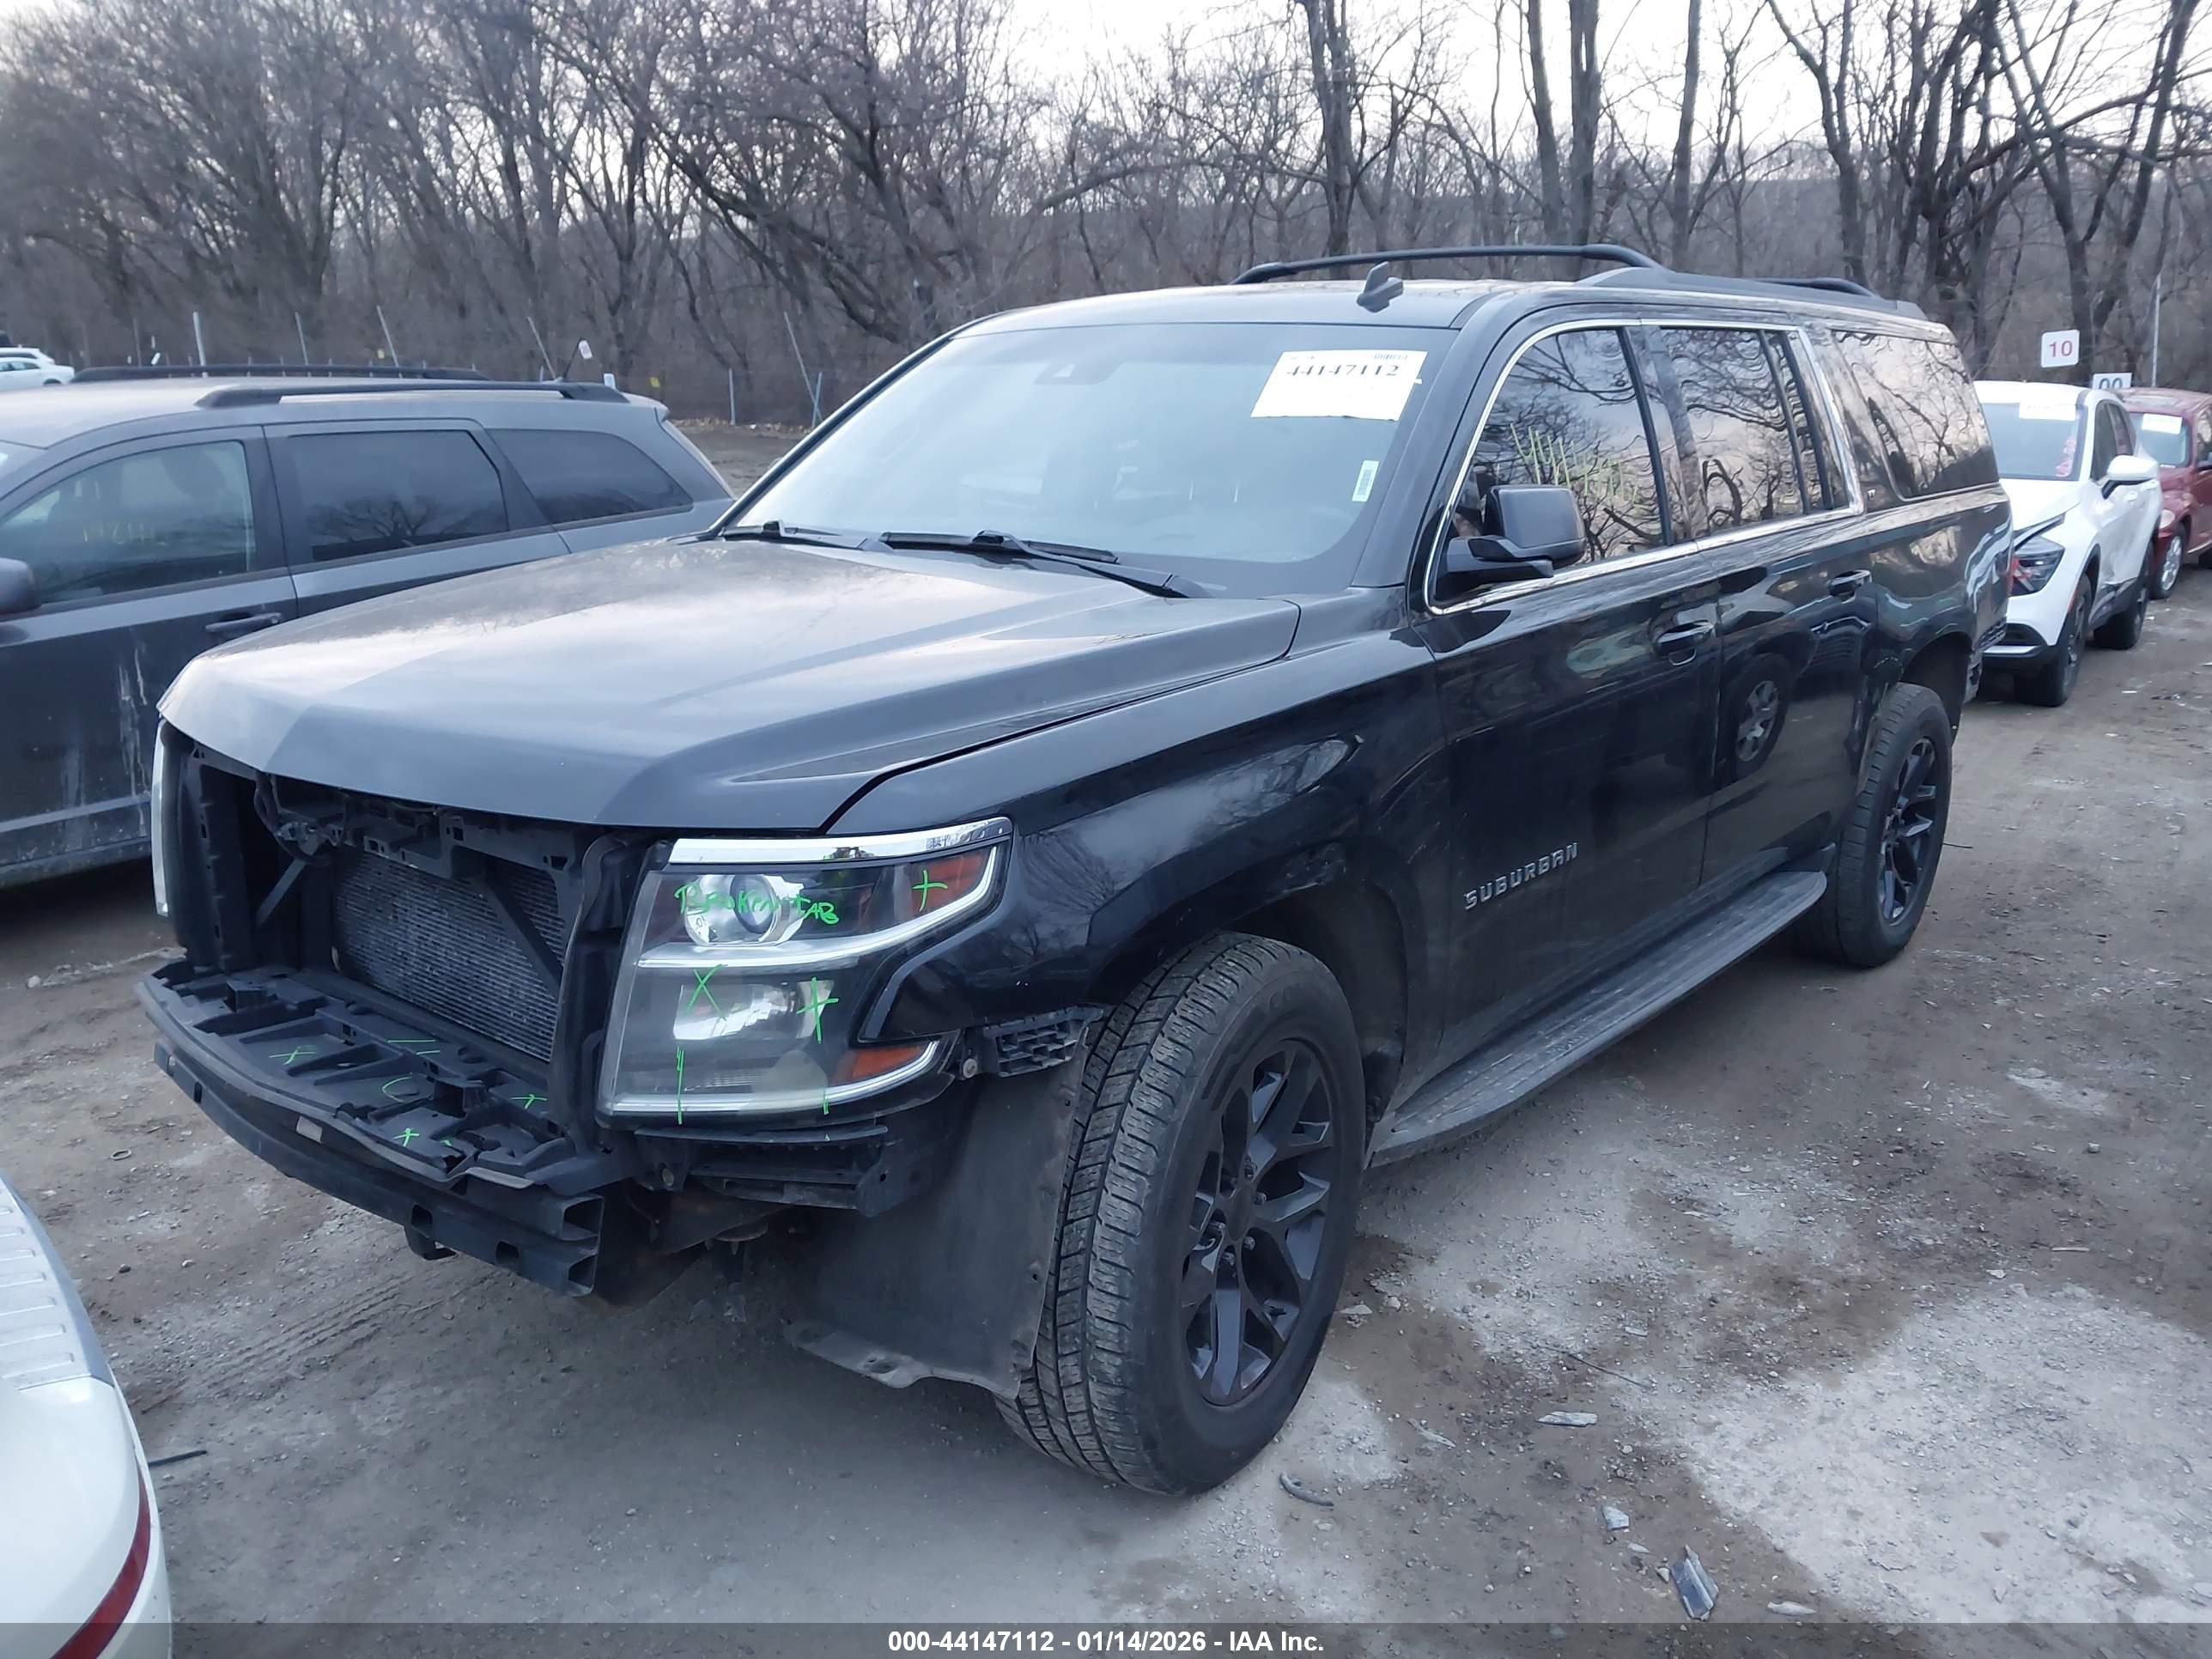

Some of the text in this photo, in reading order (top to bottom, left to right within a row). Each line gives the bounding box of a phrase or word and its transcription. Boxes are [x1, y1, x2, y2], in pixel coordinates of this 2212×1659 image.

[2049, 340, 2073, 357] 10
[1285, 364, 1400, 376] 44147112
[1463, 842, 1578, 910] SUBURBAN
